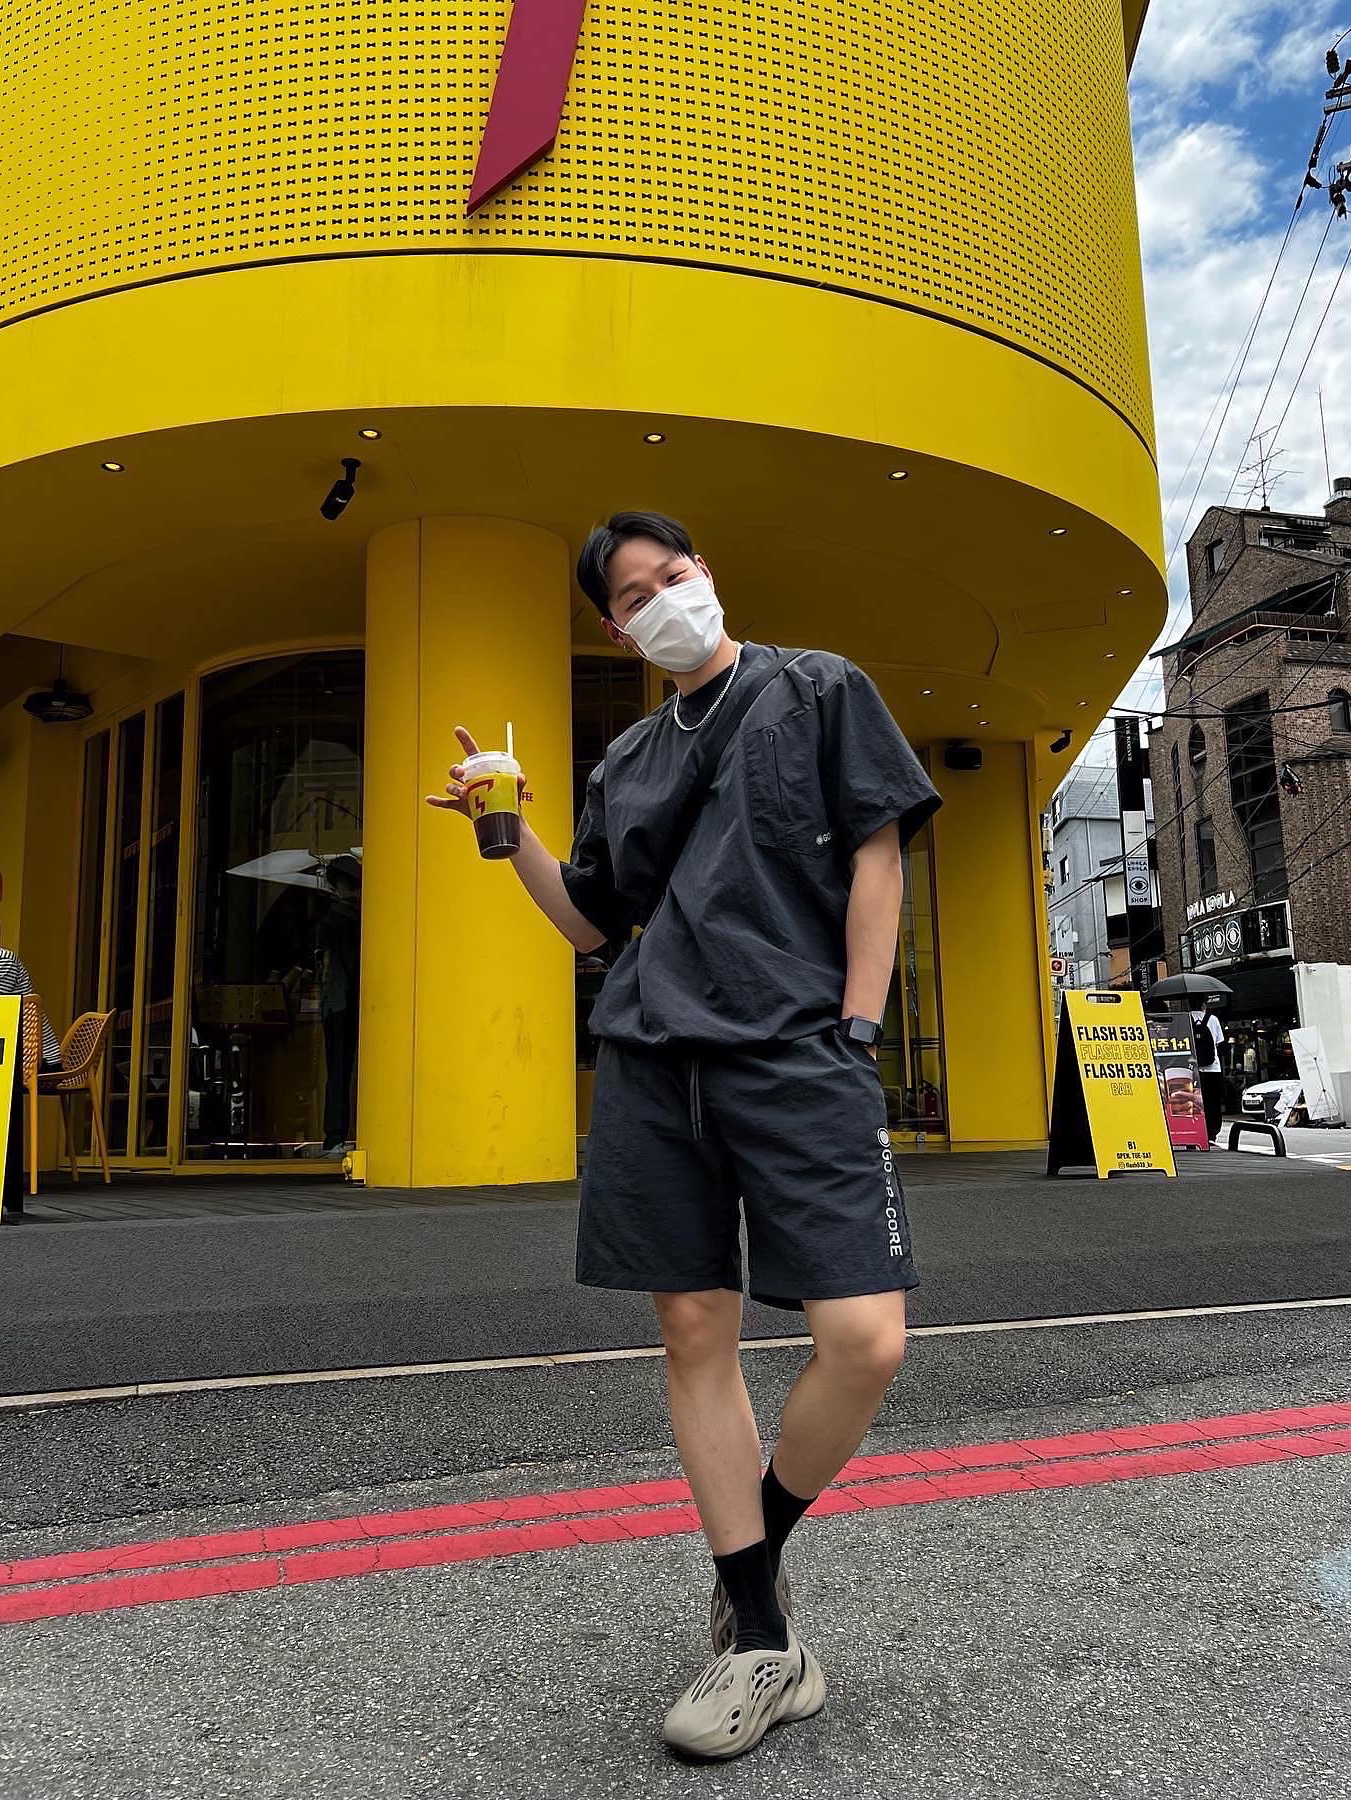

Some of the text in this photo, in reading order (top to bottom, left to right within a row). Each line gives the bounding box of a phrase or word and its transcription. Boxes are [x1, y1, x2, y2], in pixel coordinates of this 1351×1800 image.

[1076, 1026, 1118, 1041] FLASH
[1119, 1026, 1145, 1041] 533
[1080, 1044, 1149, 1061] FLASH 533
[1083, 1063, 1153, 1079] FLASH 533
[1110, 1083, 1133, 1096] BAR
